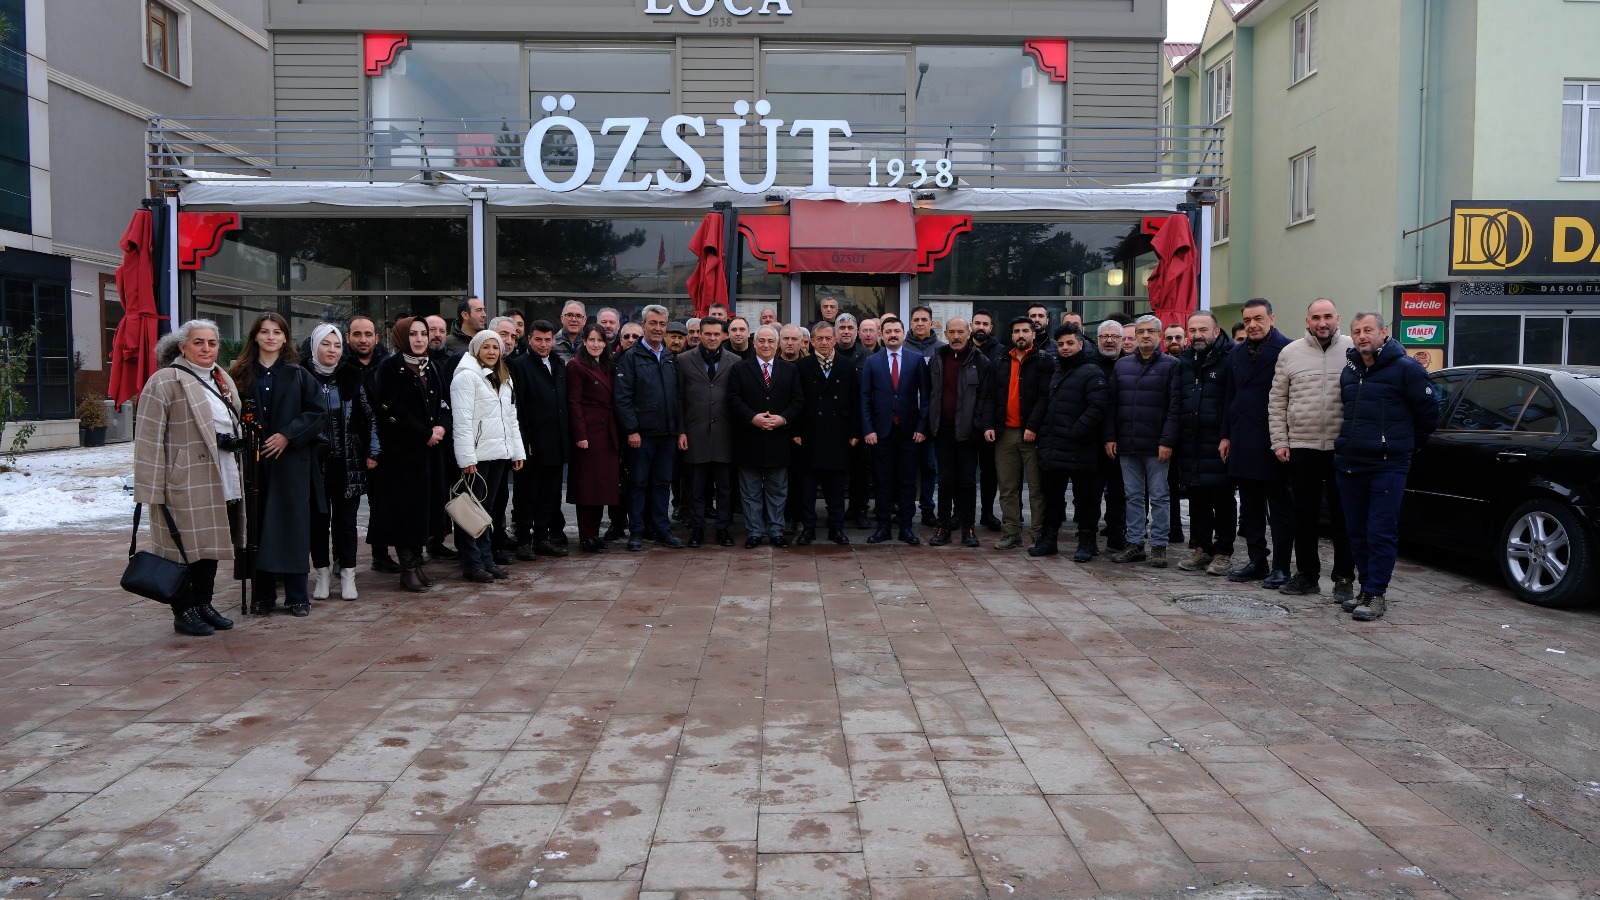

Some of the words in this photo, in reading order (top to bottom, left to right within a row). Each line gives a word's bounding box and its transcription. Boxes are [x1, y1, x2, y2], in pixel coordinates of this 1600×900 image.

[708, 17, 732, 28] 1938
[523, 94, 853, 194] ÖZSÜT
[867, 158, 954, 188] 1938
[1552, 216, 1600, 263] D
[831, 251, 867, 264] ÖZSÜT
[1404, 300, 1442, 309] tadelle
[1408, 327, 1434, 336] TAMEK
